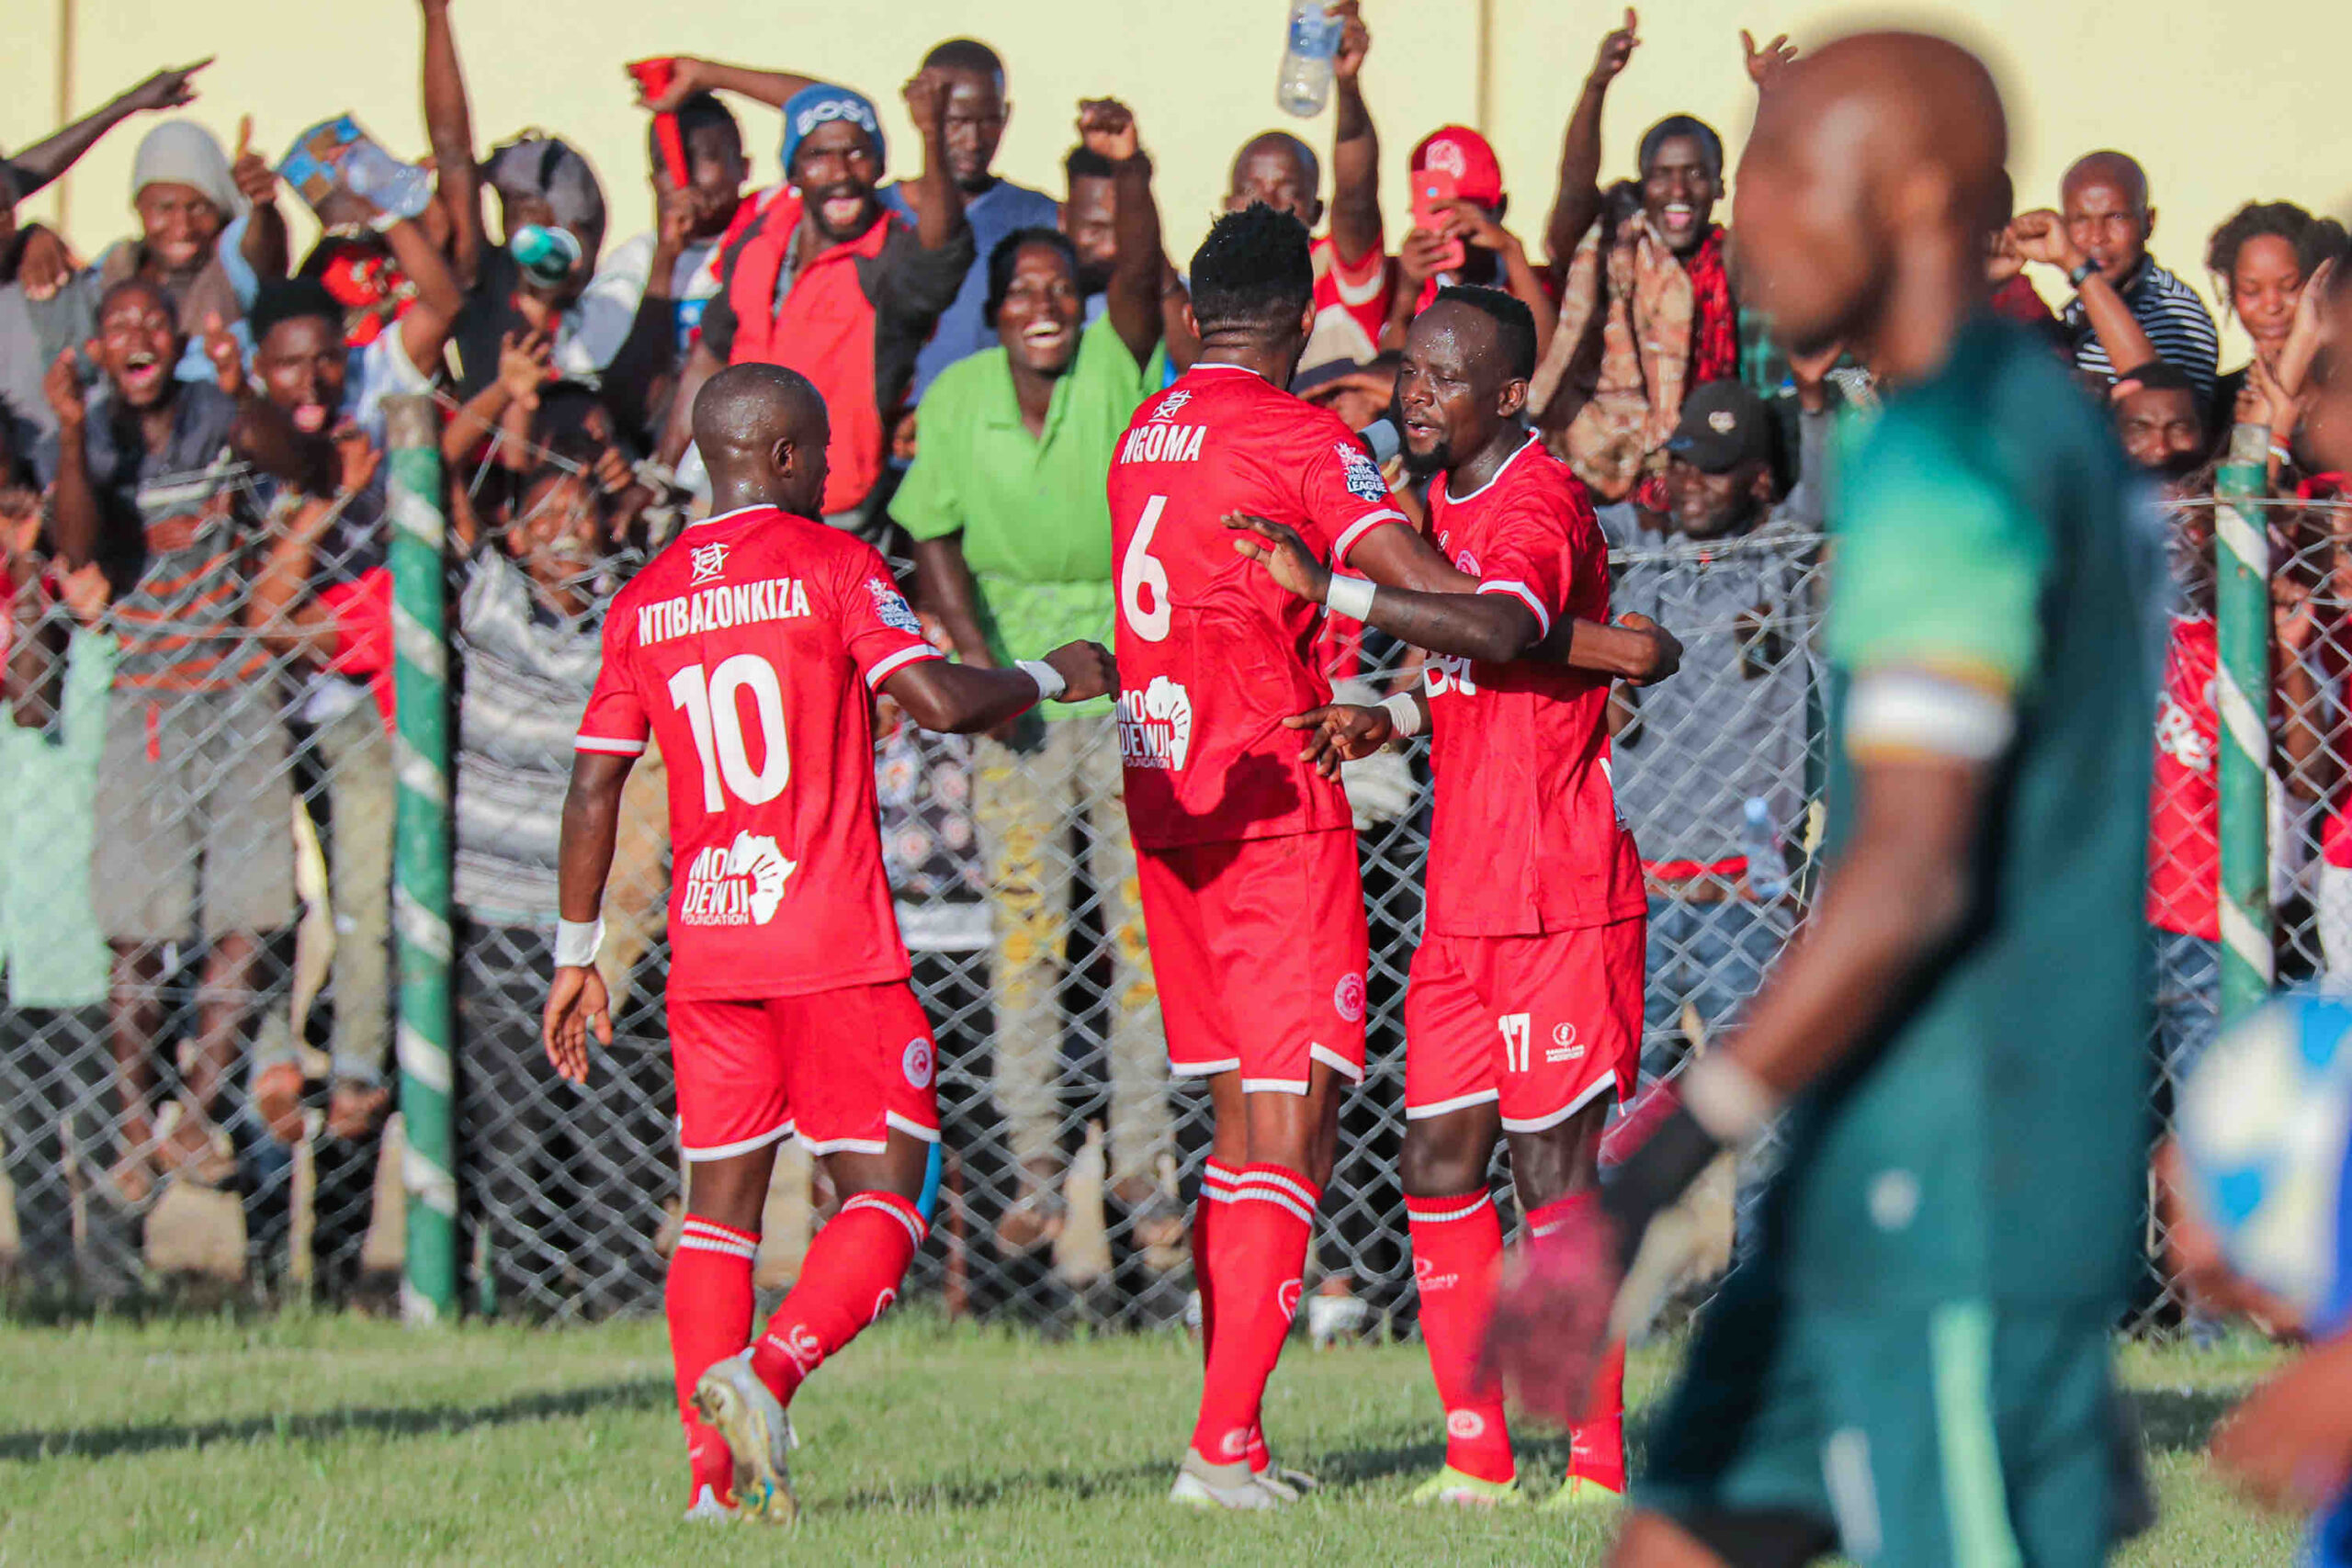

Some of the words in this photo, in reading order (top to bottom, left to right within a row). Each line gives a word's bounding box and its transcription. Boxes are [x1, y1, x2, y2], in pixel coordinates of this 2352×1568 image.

[1120, 423, 1207, 465] NGOMA
[1346, 480, 1387, 493] LEAGUE
[1349, 465, 1374, 476] NBC
[1121, 495, 1171, 642] 6
[638, 577, 811, 647] NTIBAZONKIZA
[1117, 690, 1147, 724] MO
[667, 653, 790, 813] 10
[1120, 723, 1170, 757] DEWJI
[688, 846, 729, 881] MO
[682, 879, 750, 914] DEWJI
[681, 912, 750, 927] FOUNDATION
[1498, 1012, 1531, 1073] 17
